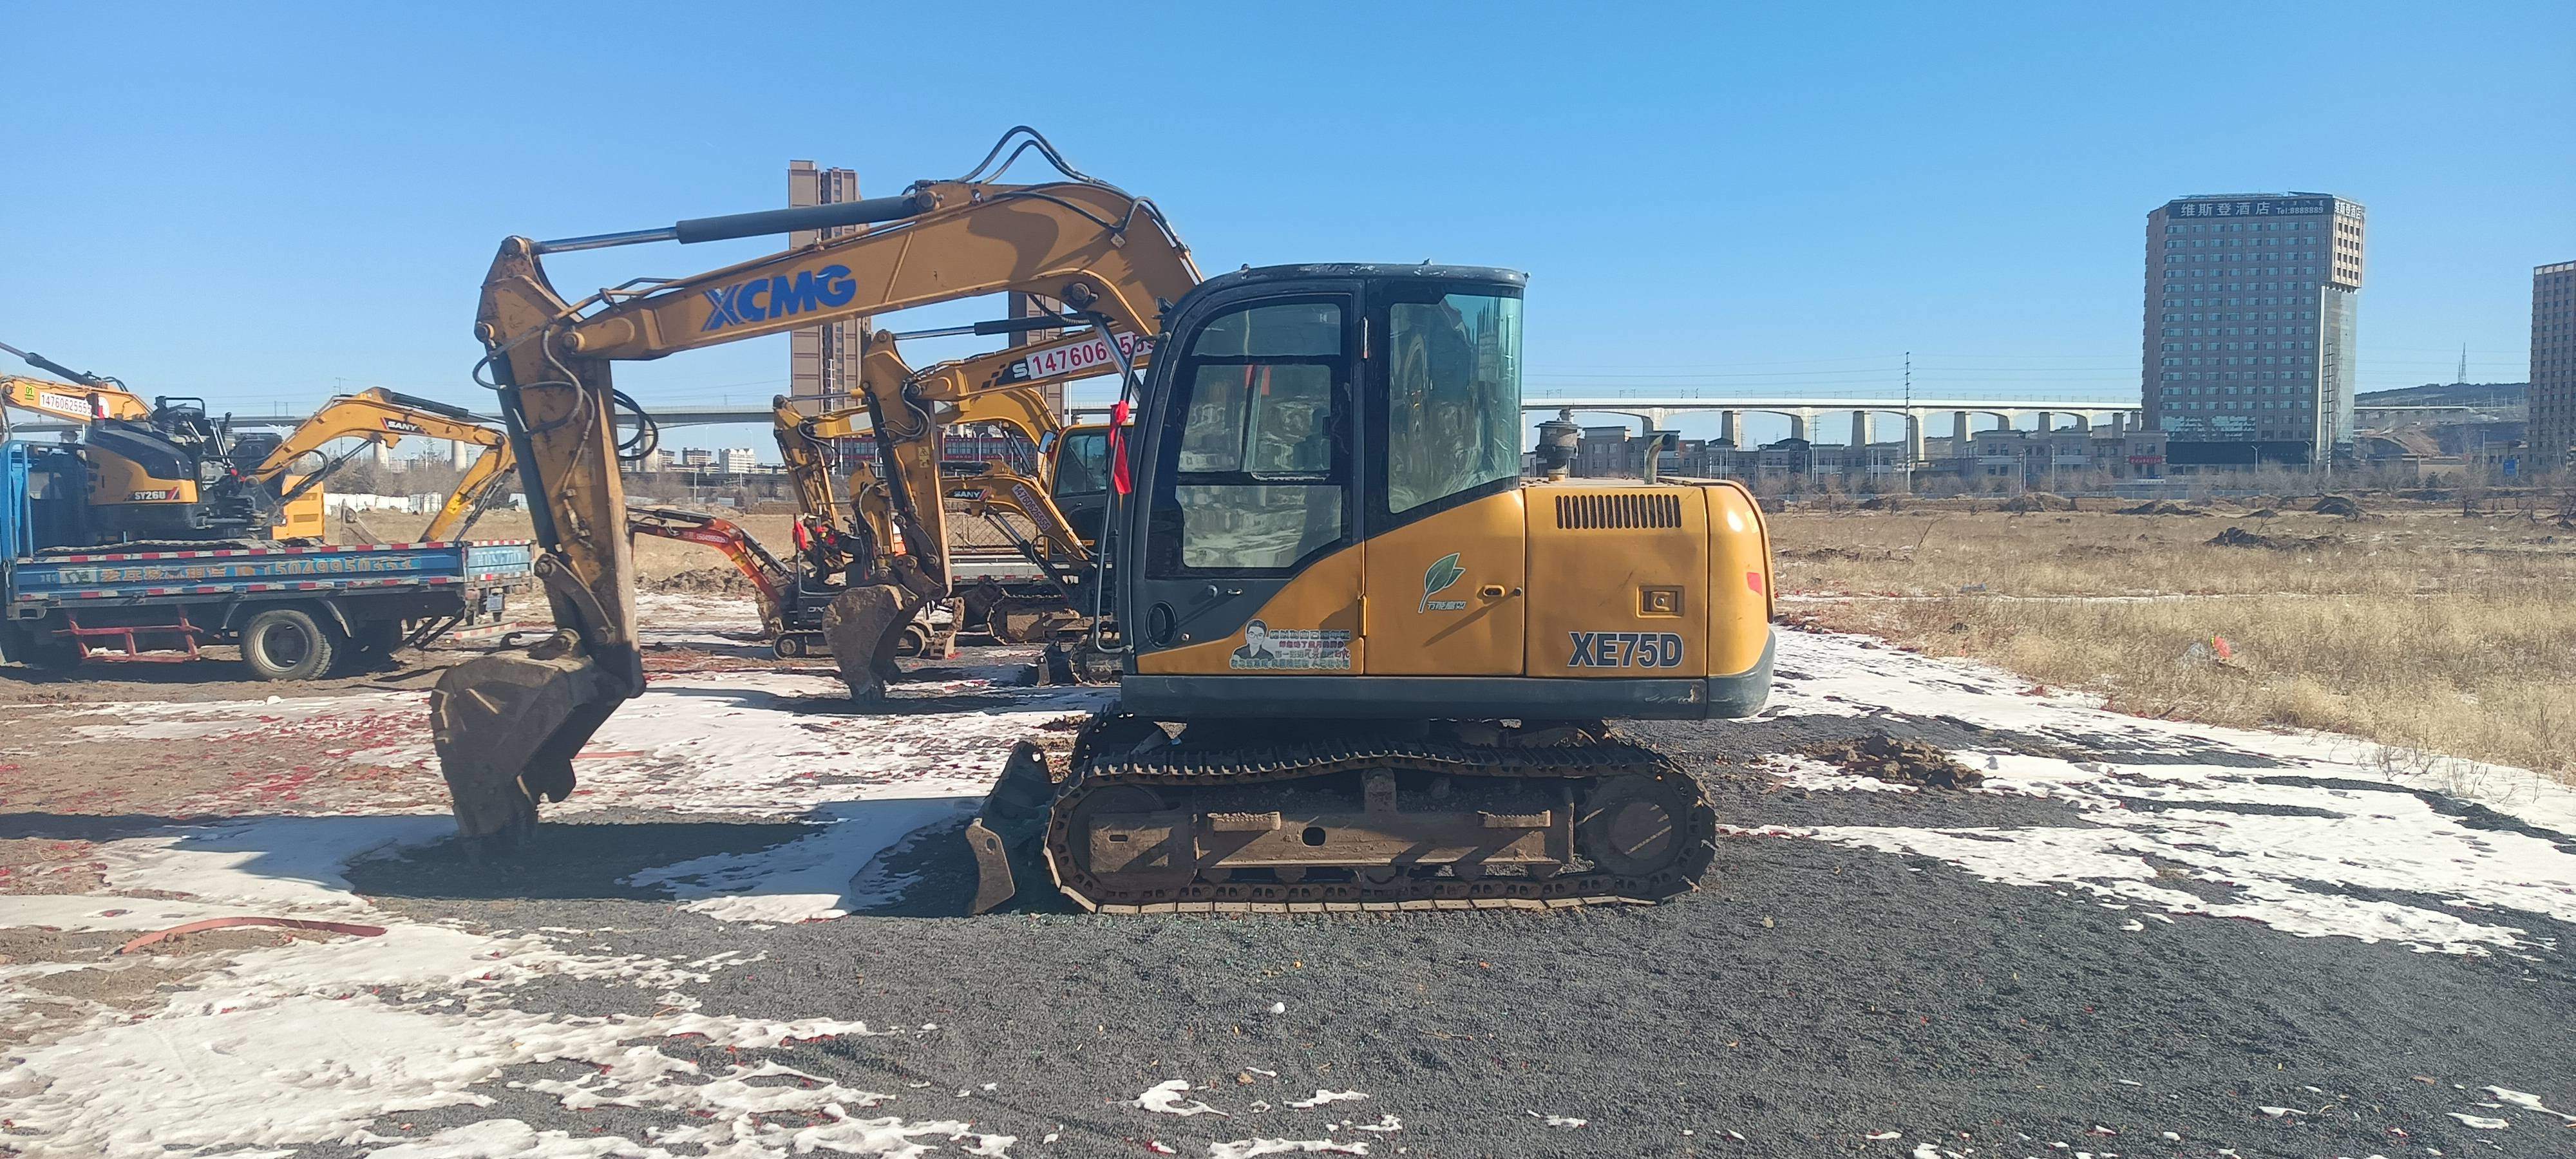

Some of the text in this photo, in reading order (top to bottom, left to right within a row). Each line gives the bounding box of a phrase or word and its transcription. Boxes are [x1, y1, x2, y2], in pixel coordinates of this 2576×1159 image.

[2181, 202, 2269, 217] 维斯登酒店
[701, 265, 857, 332] XCMG
[388, 420, 418, 431] SANY
[135, 491, 166, 500] SY26U
[1567, 631, 1684, 668] XE75D
